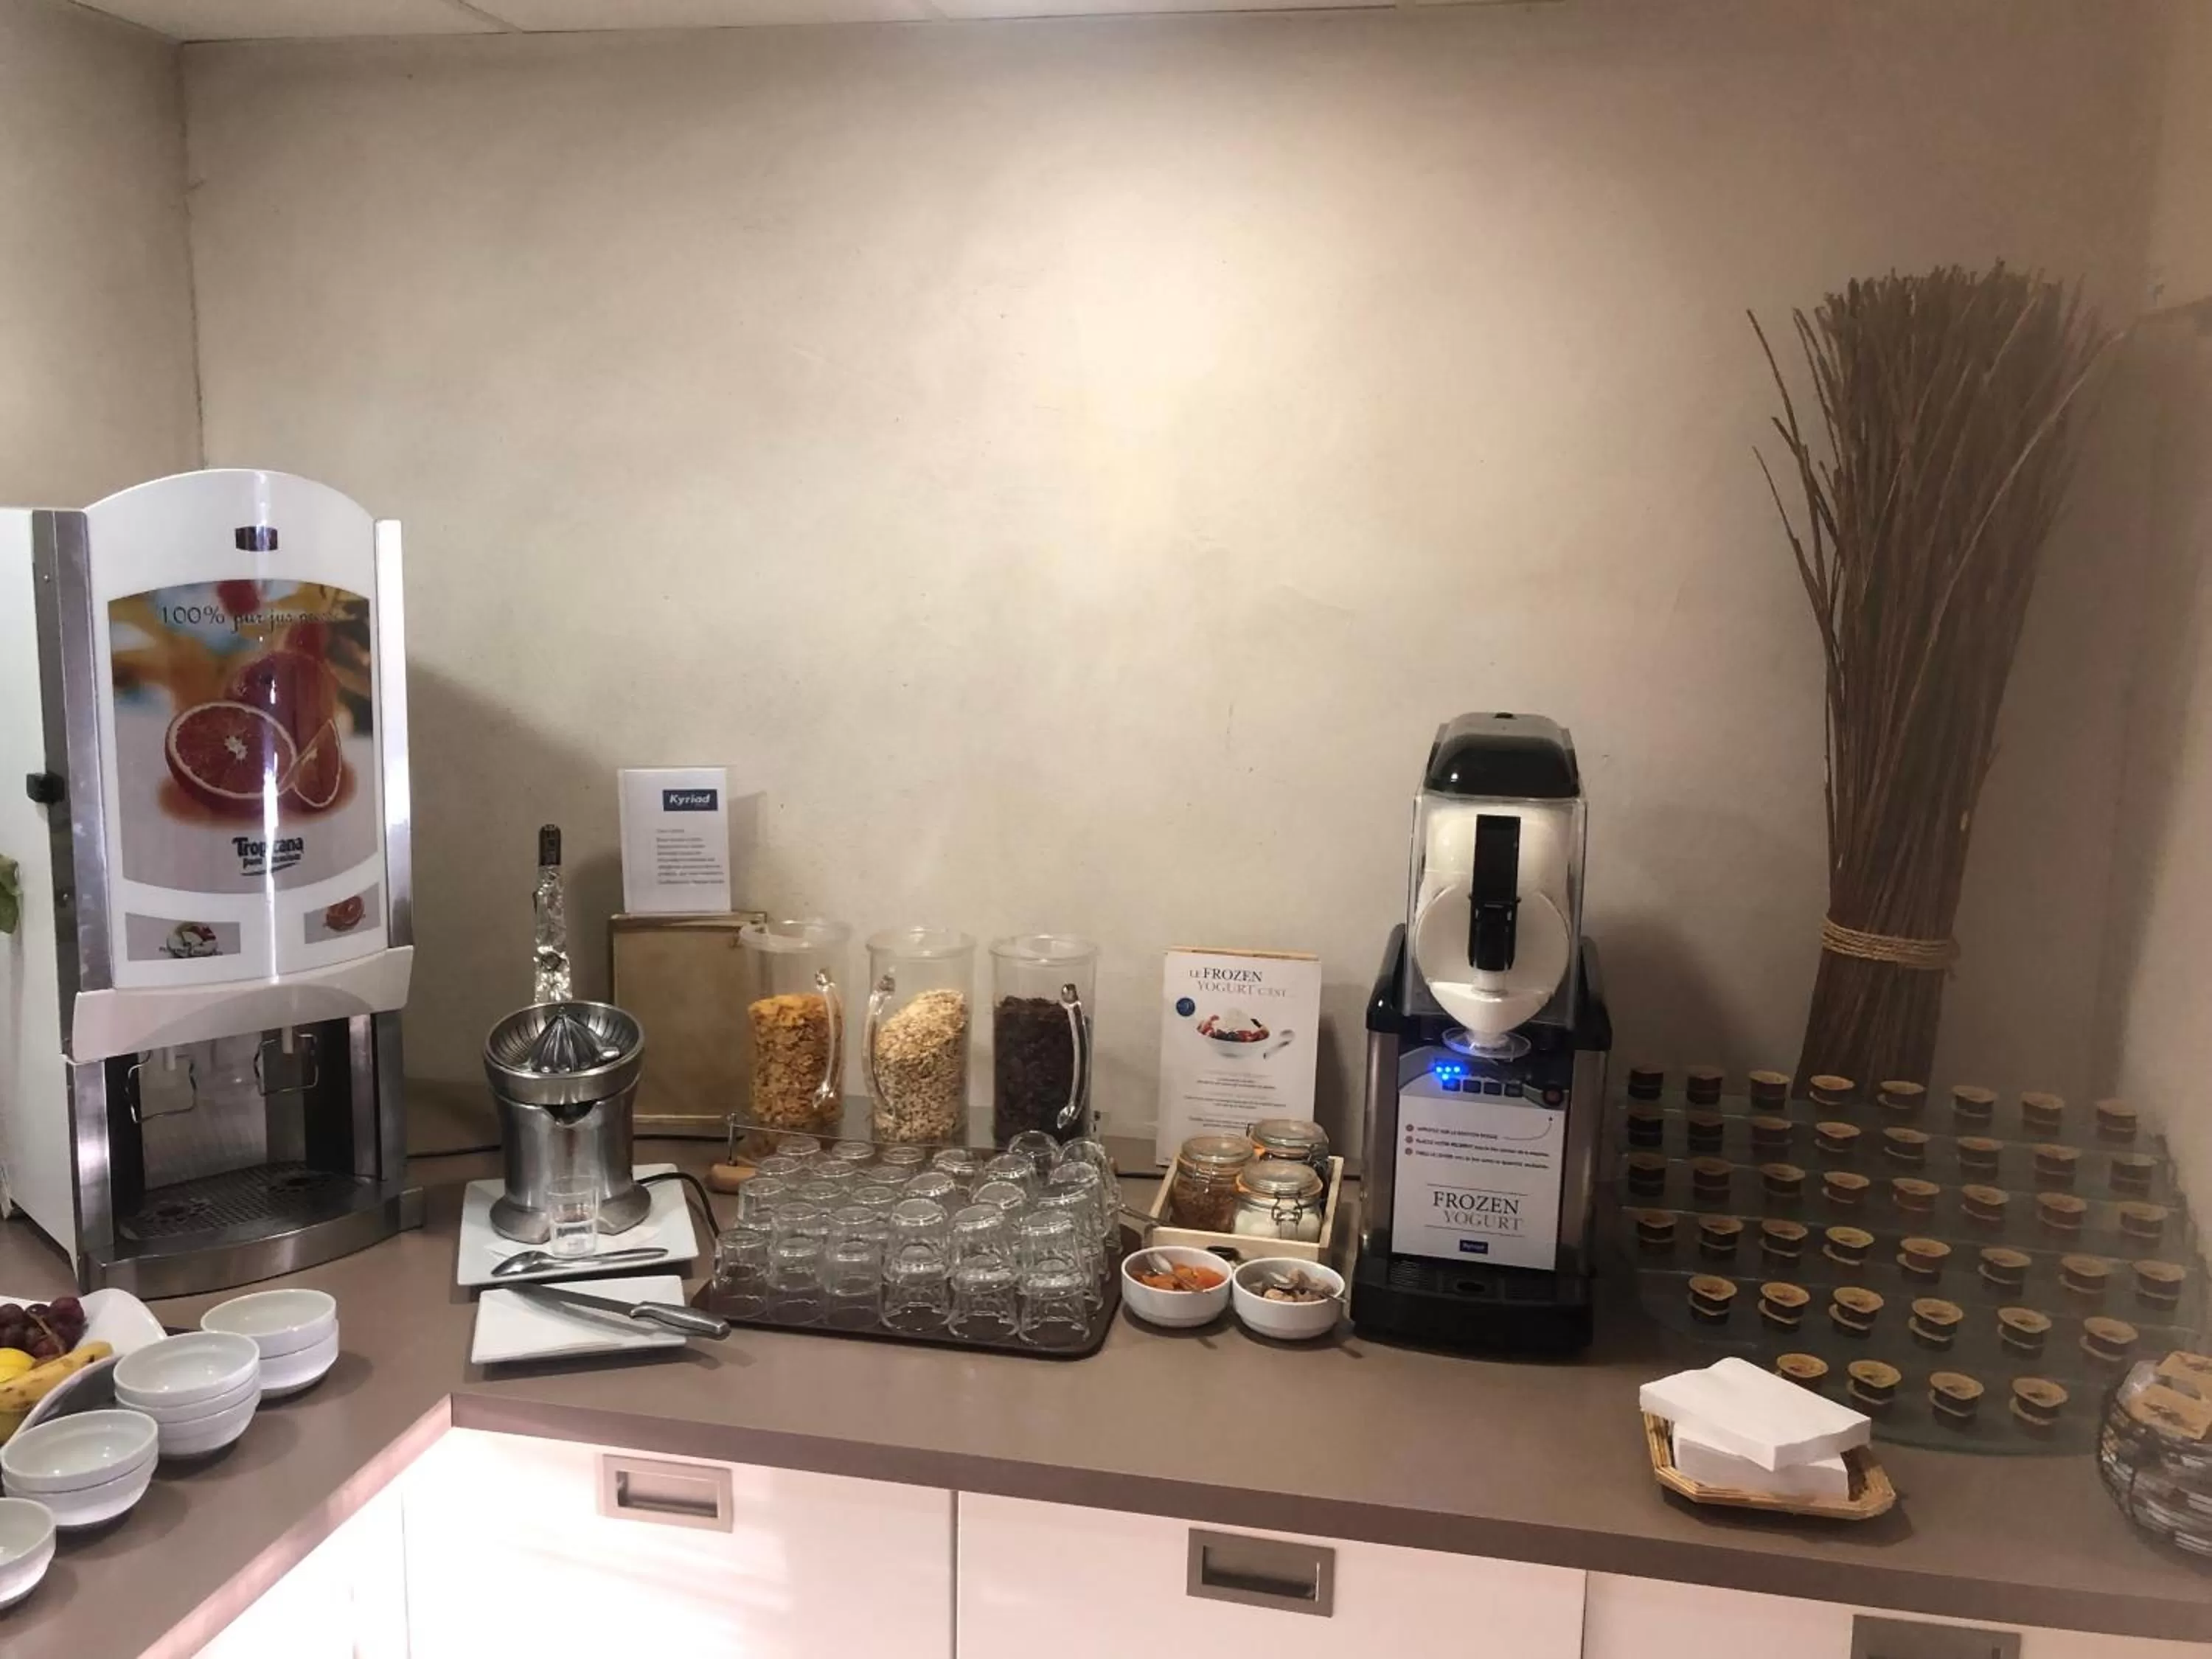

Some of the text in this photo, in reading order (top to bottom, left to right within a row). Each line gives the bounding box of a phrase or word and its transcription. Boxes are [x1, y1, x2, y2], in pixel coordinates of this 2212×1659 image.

[161, 605, 226, 625] 100%
[669, 793, 711, 806] Kyriad
[232, 837, 304, 858] Tropcana
[1203, 967, 1262, 983] FROZEN
[1197, 980, 1254, 995] YOGURT
[1433, 1191, 1519, 1214] FROZEN
[1443, 1210, 1523, 1231] YOGURT
